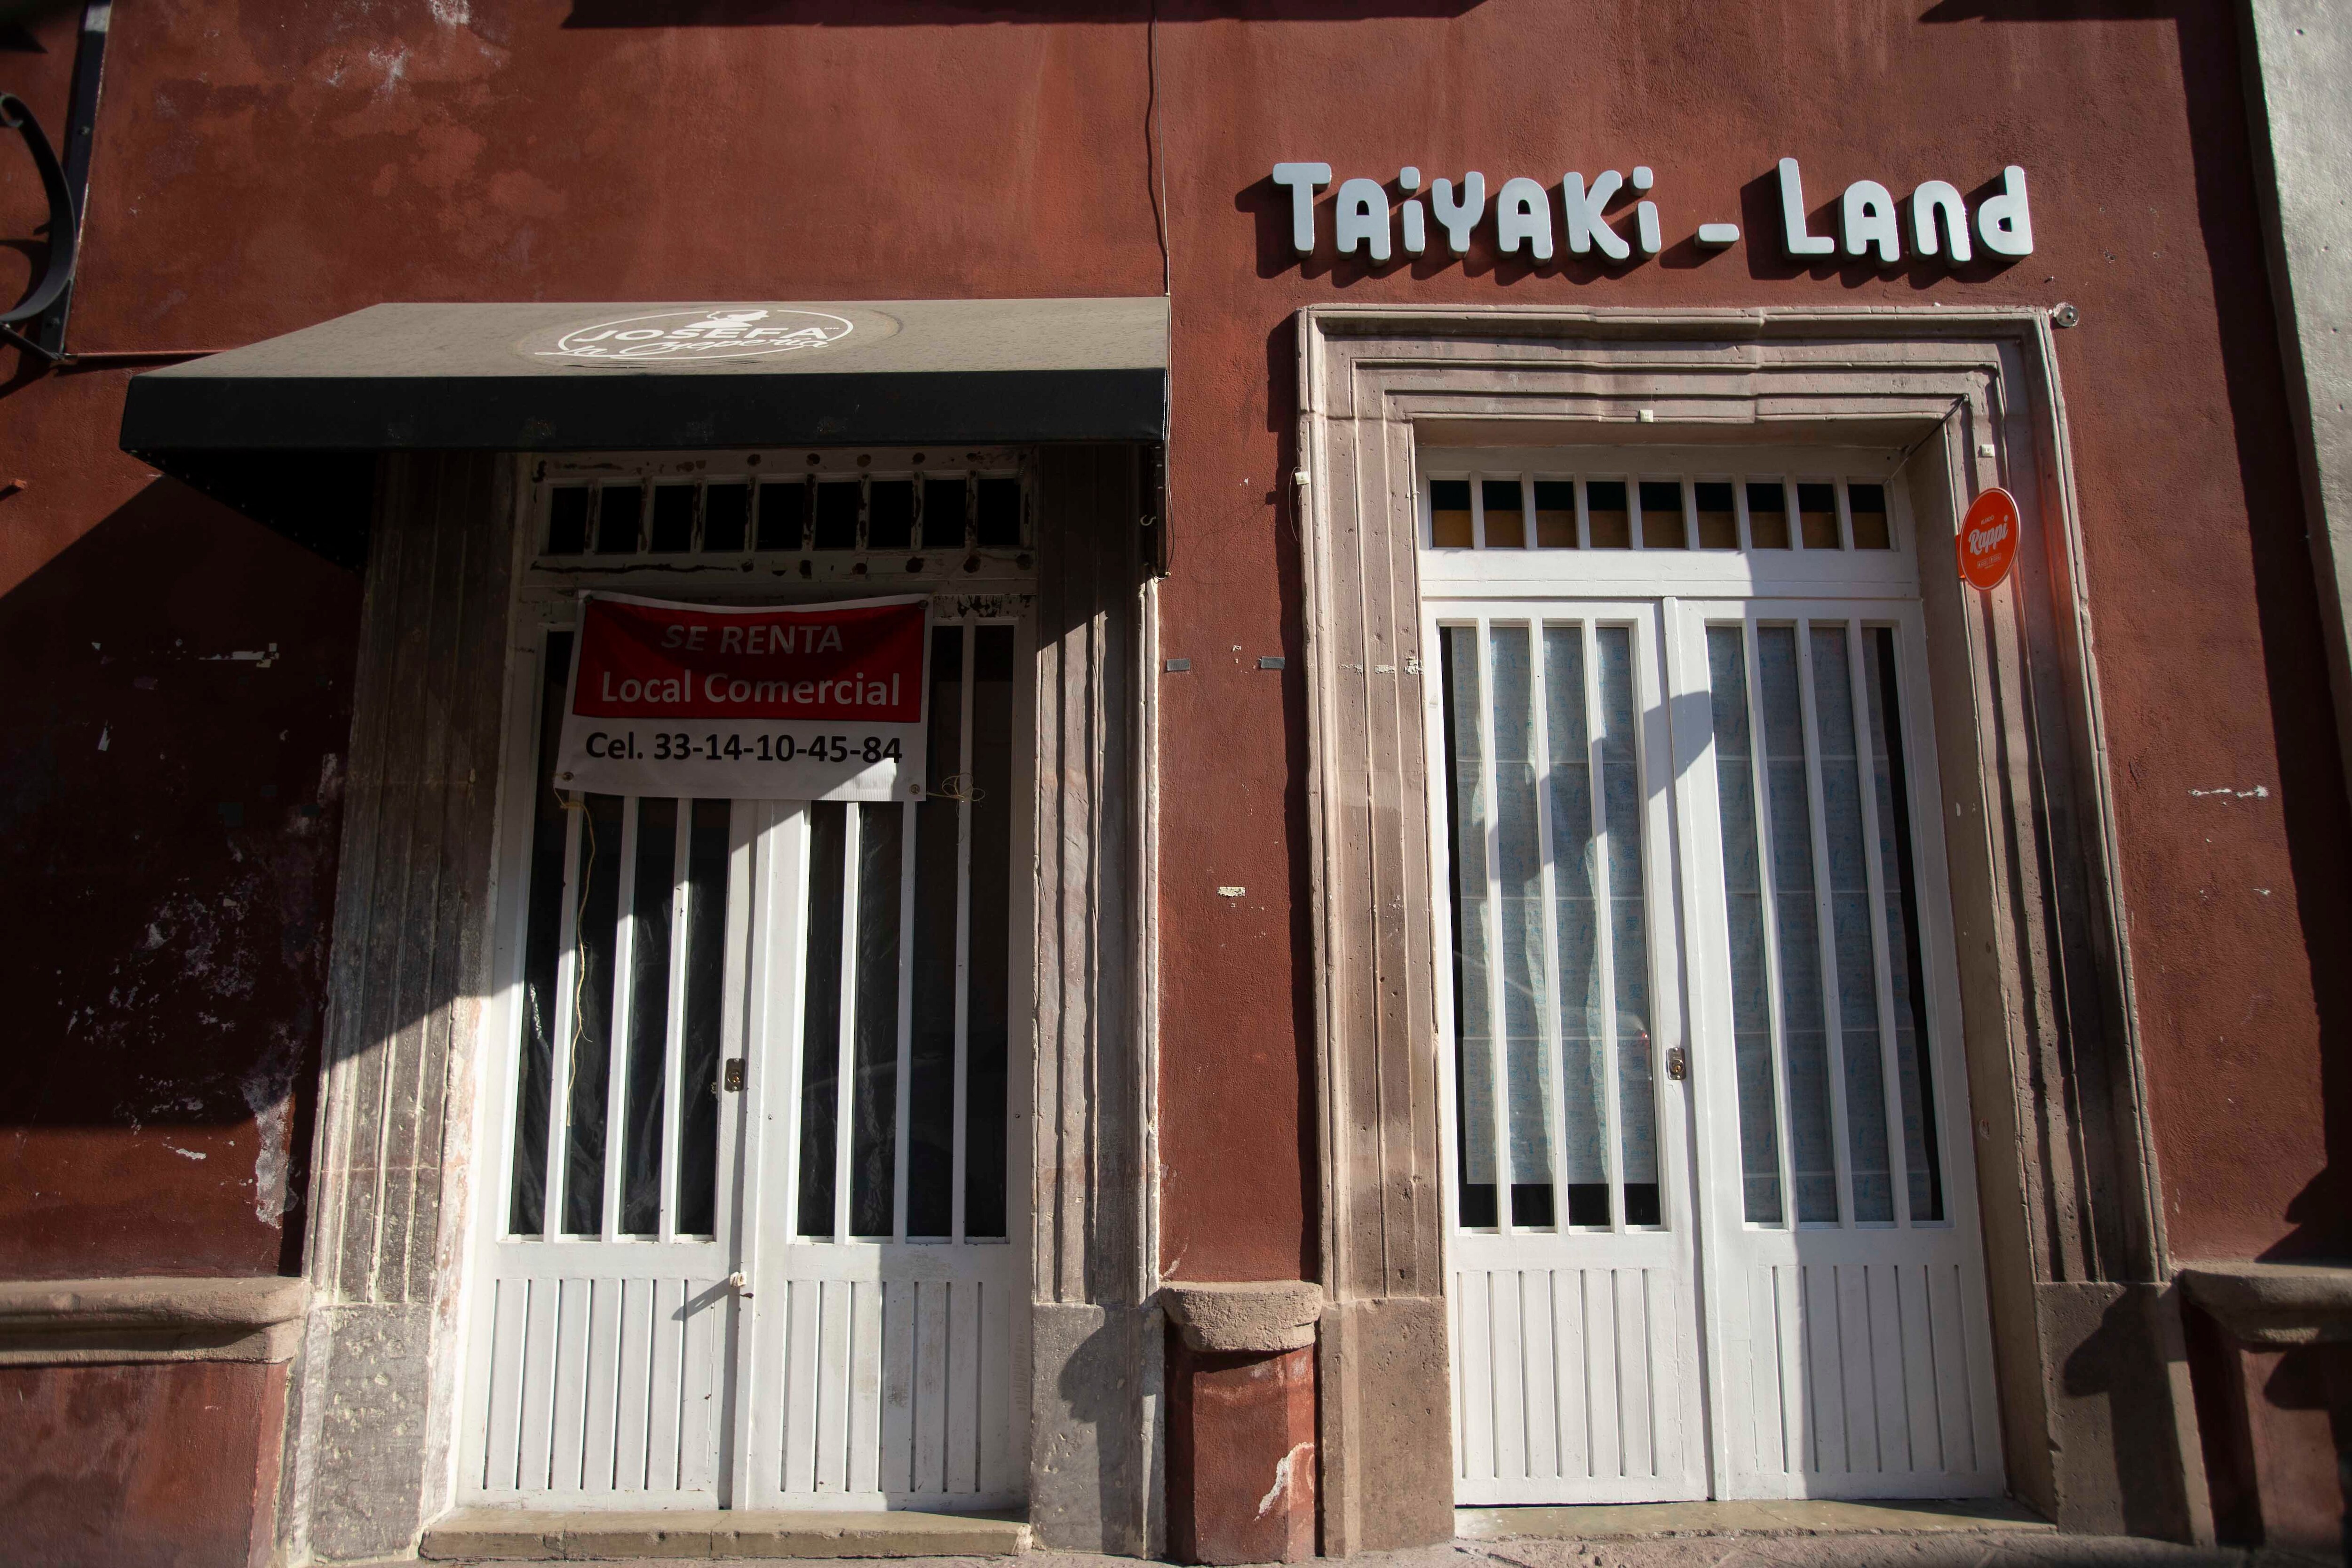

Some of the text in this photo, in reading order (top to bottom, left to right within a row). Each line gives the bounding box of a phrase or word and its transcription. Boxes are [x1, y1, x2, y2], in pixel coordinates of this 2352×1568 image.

[572, 327, 828, 342] JOSEFA
[1968, 515, 2009, 556] Rappi
[660, 624, 844, 654] SE RENTA
[602, 669, 901, 706] Local Comercial
[586, 732, 902, 764] Cel. 33-14-10-45-84
